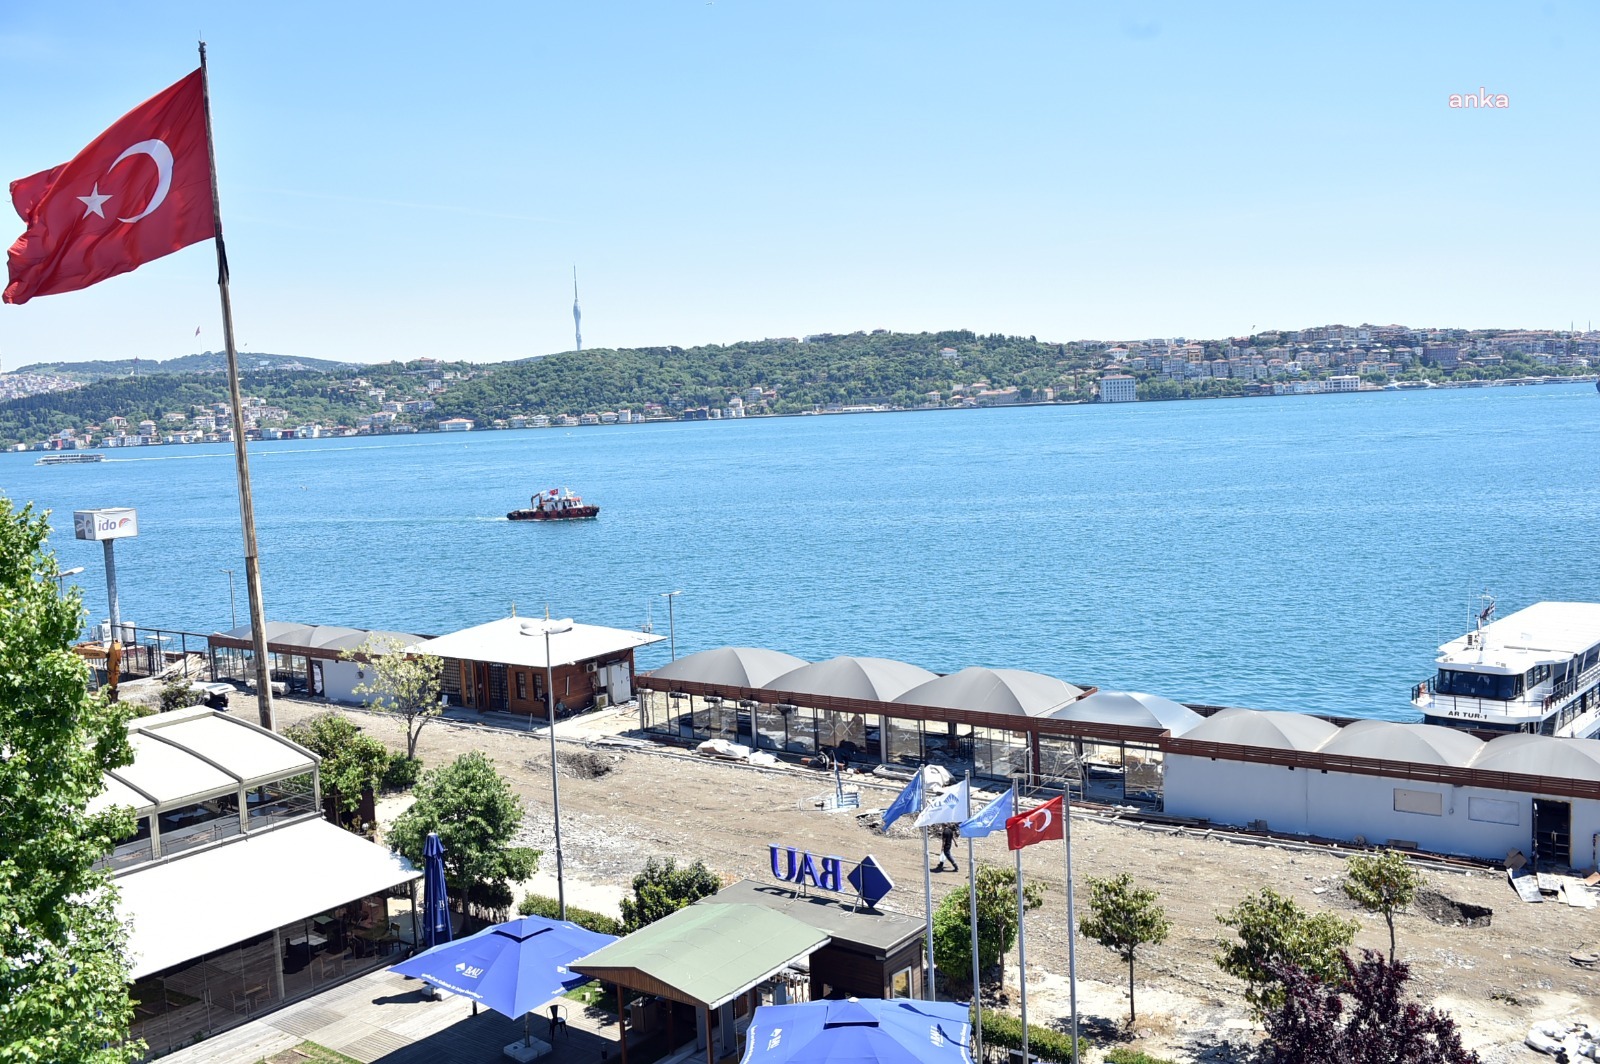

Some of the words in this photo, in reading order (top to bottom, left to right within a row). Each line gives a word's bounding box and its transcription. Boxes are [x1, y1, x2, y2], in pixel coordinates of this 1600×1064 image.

[98, 520, 117, 531] ido
[1463, 712, 1488, 720] TUR-1
[464, 965, 484, 977] BAU
